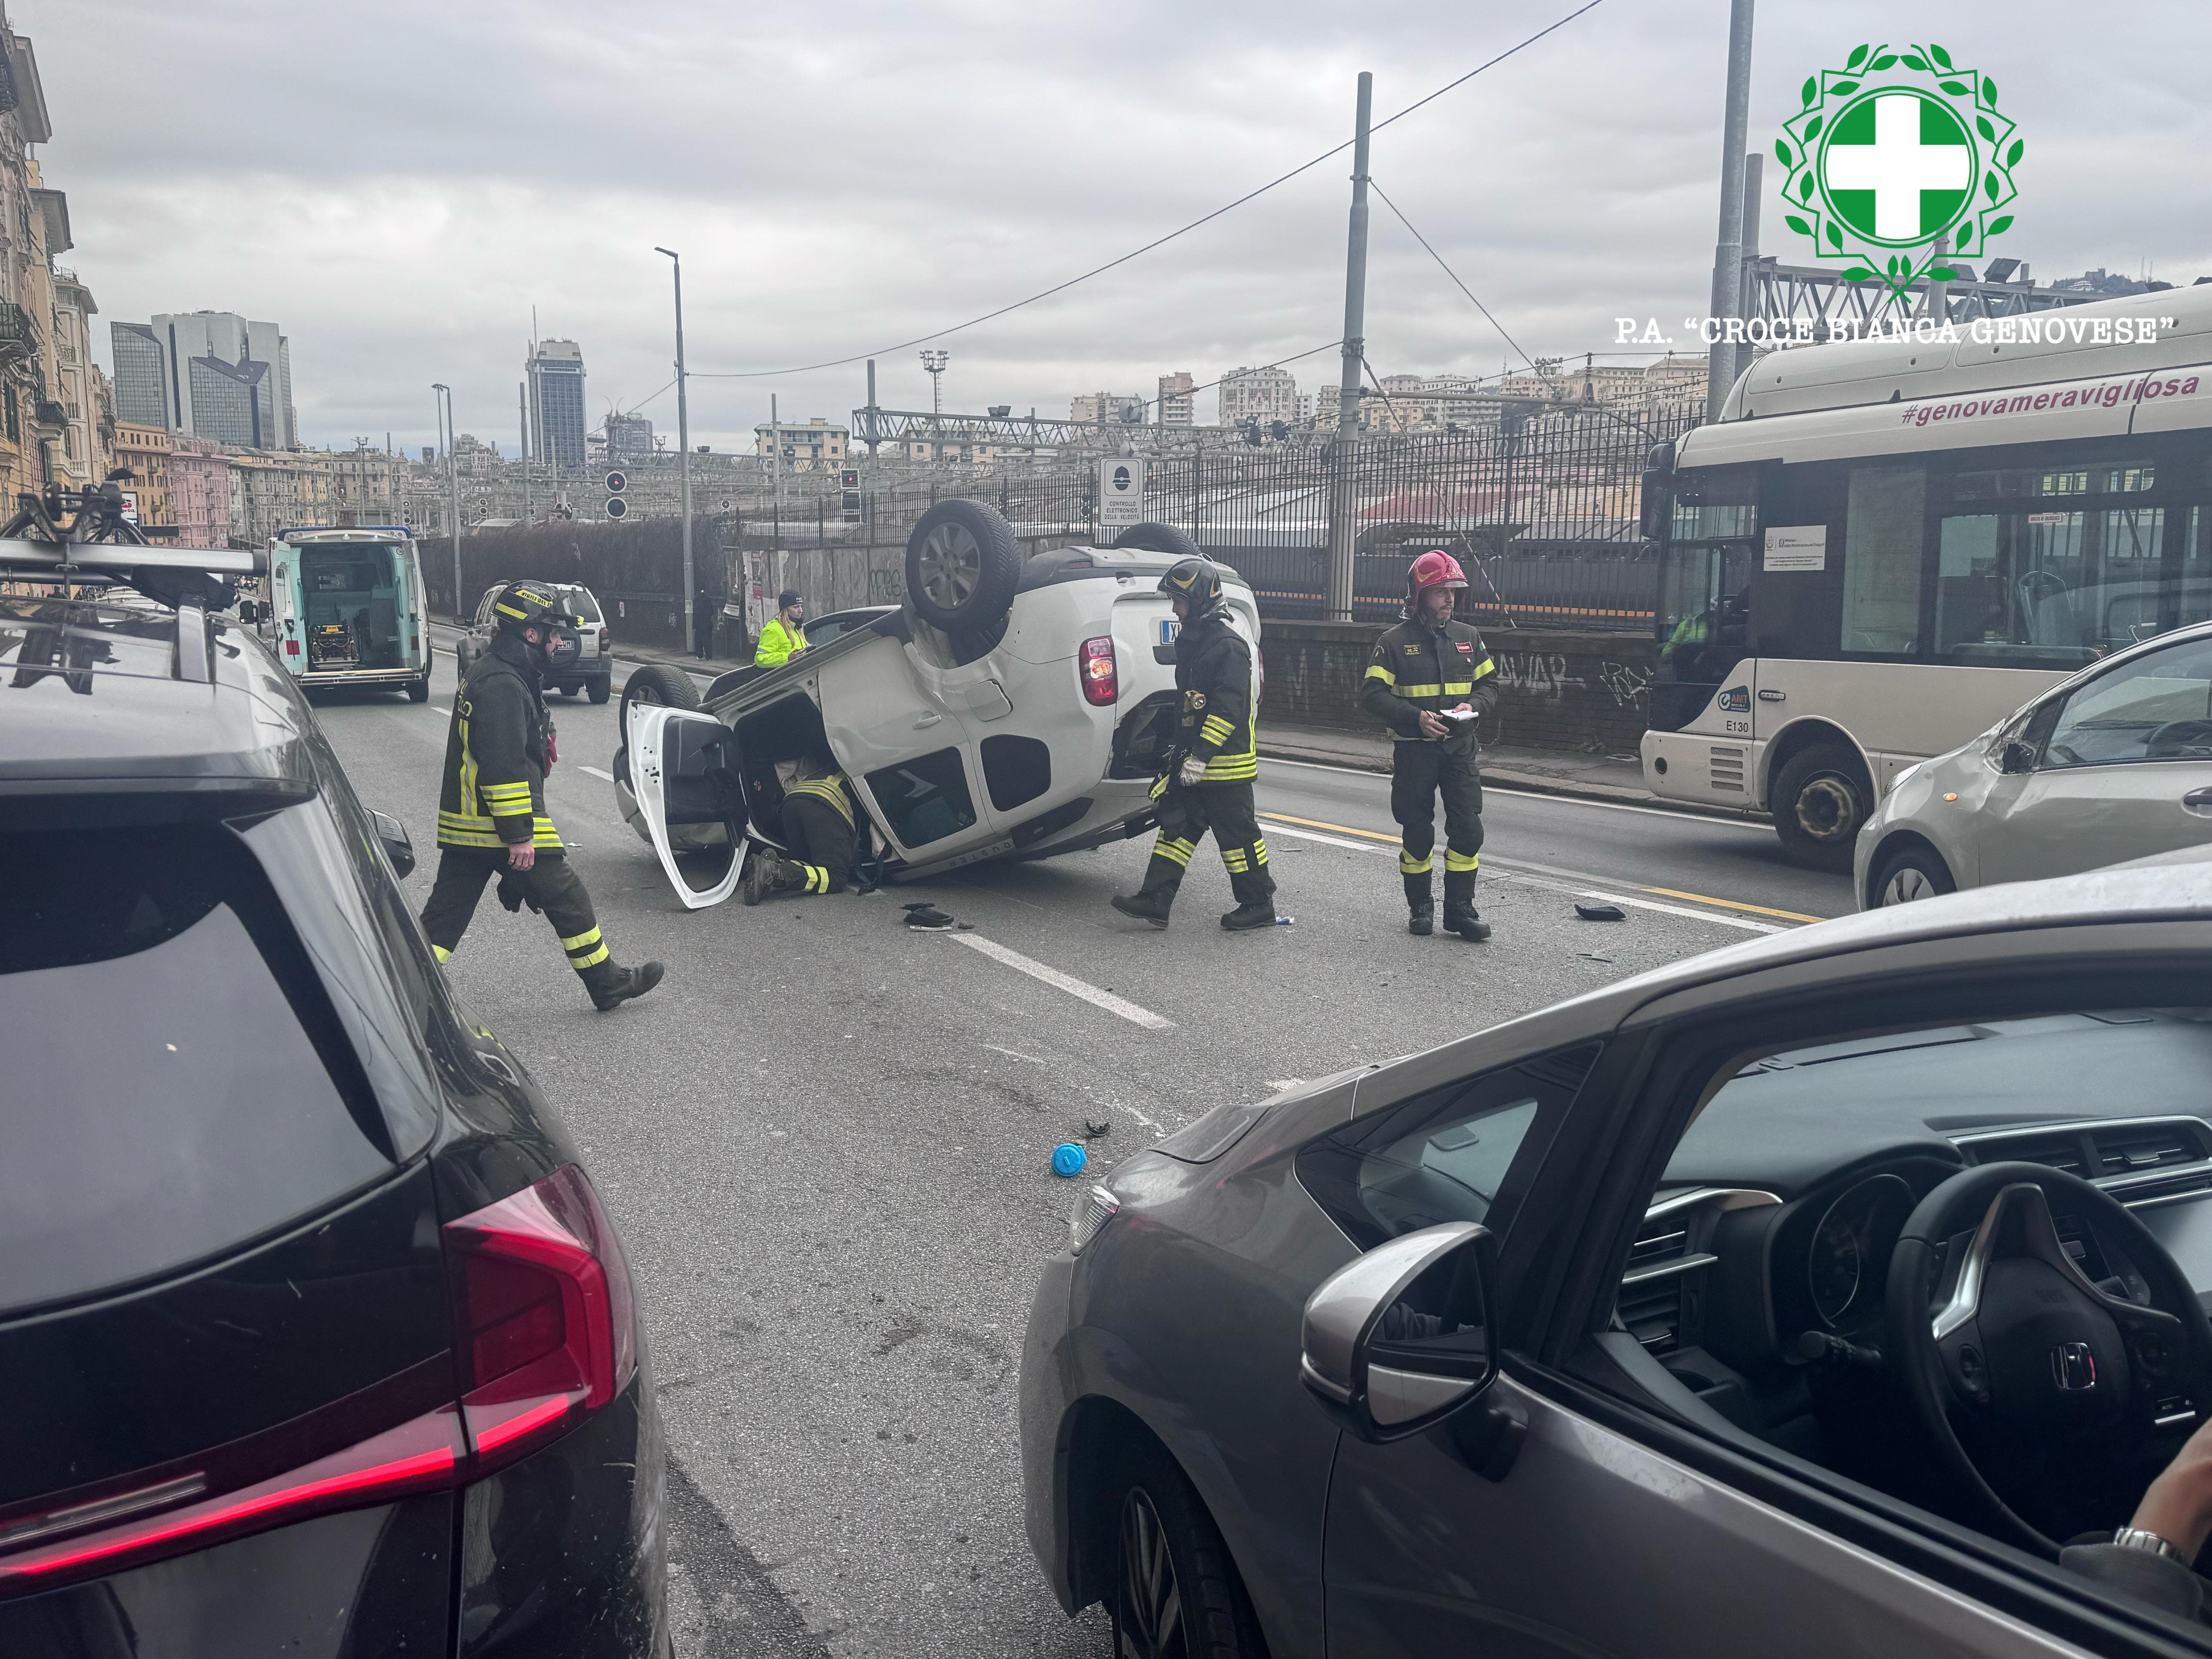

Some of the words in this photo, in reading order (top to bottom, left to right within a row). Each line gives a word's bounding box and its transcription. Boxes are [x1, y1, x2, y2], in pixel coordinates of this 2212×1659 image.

[1902, 376, 2199, 427] #genovameravigliosa
[1731, 694, 1748, 703] AMT
[1726, 720, 1748, 732] E130
[948, 842, 1012, 867] DUSTER
